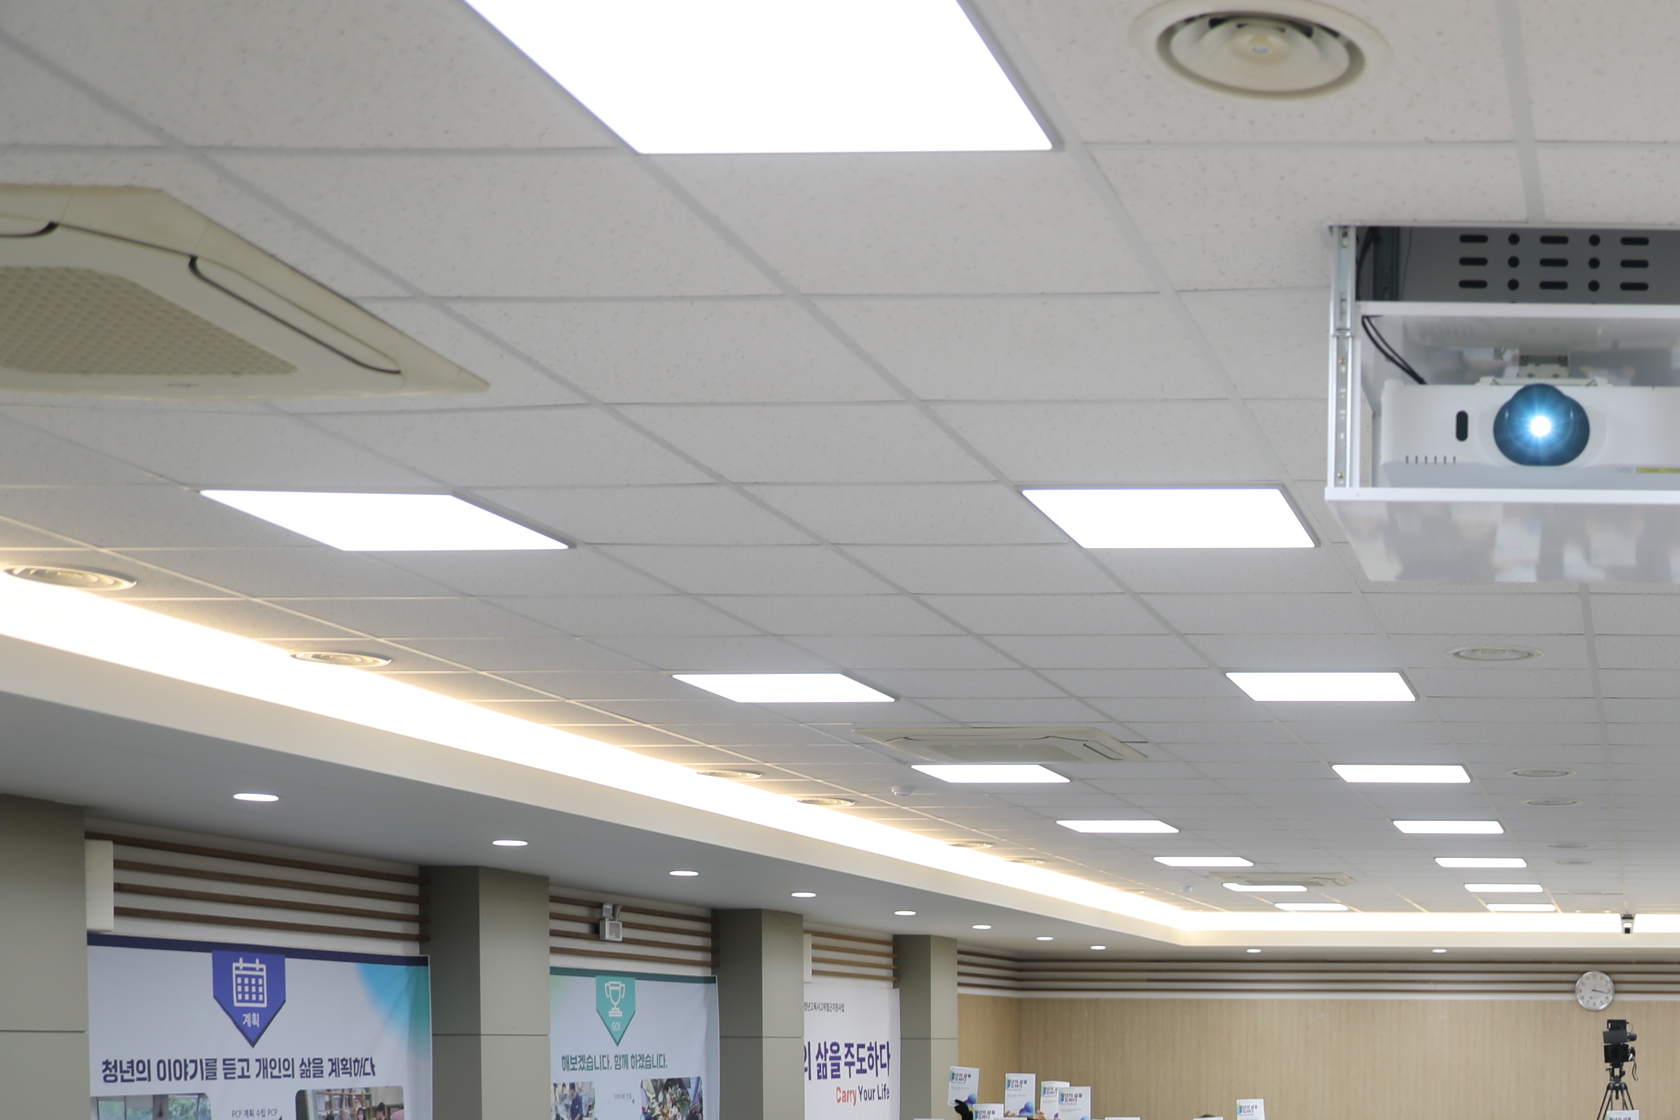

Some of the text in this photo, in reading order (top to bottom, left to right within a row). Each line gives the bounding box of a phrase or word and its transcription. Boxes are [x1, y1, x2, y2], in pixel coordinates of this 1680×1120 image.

[243, 1012, 260, 1028] 계획
[611, 1021, 621, 1032] GO!
[561, 1054, 668, 1072] 해보겠습니다. 함께 하겠습니다.
[816, 1041, 841, 1080] 삶을
[844, 1041, 891, 1078] 주도하다
[102, 1057, 376, 1083] 청년의 이야기를 듣고 개인의 삶을 계획하다
[836, 1083, 889, 1106] Carry Your Life
[244, 1109, 254, 1118] 계획
